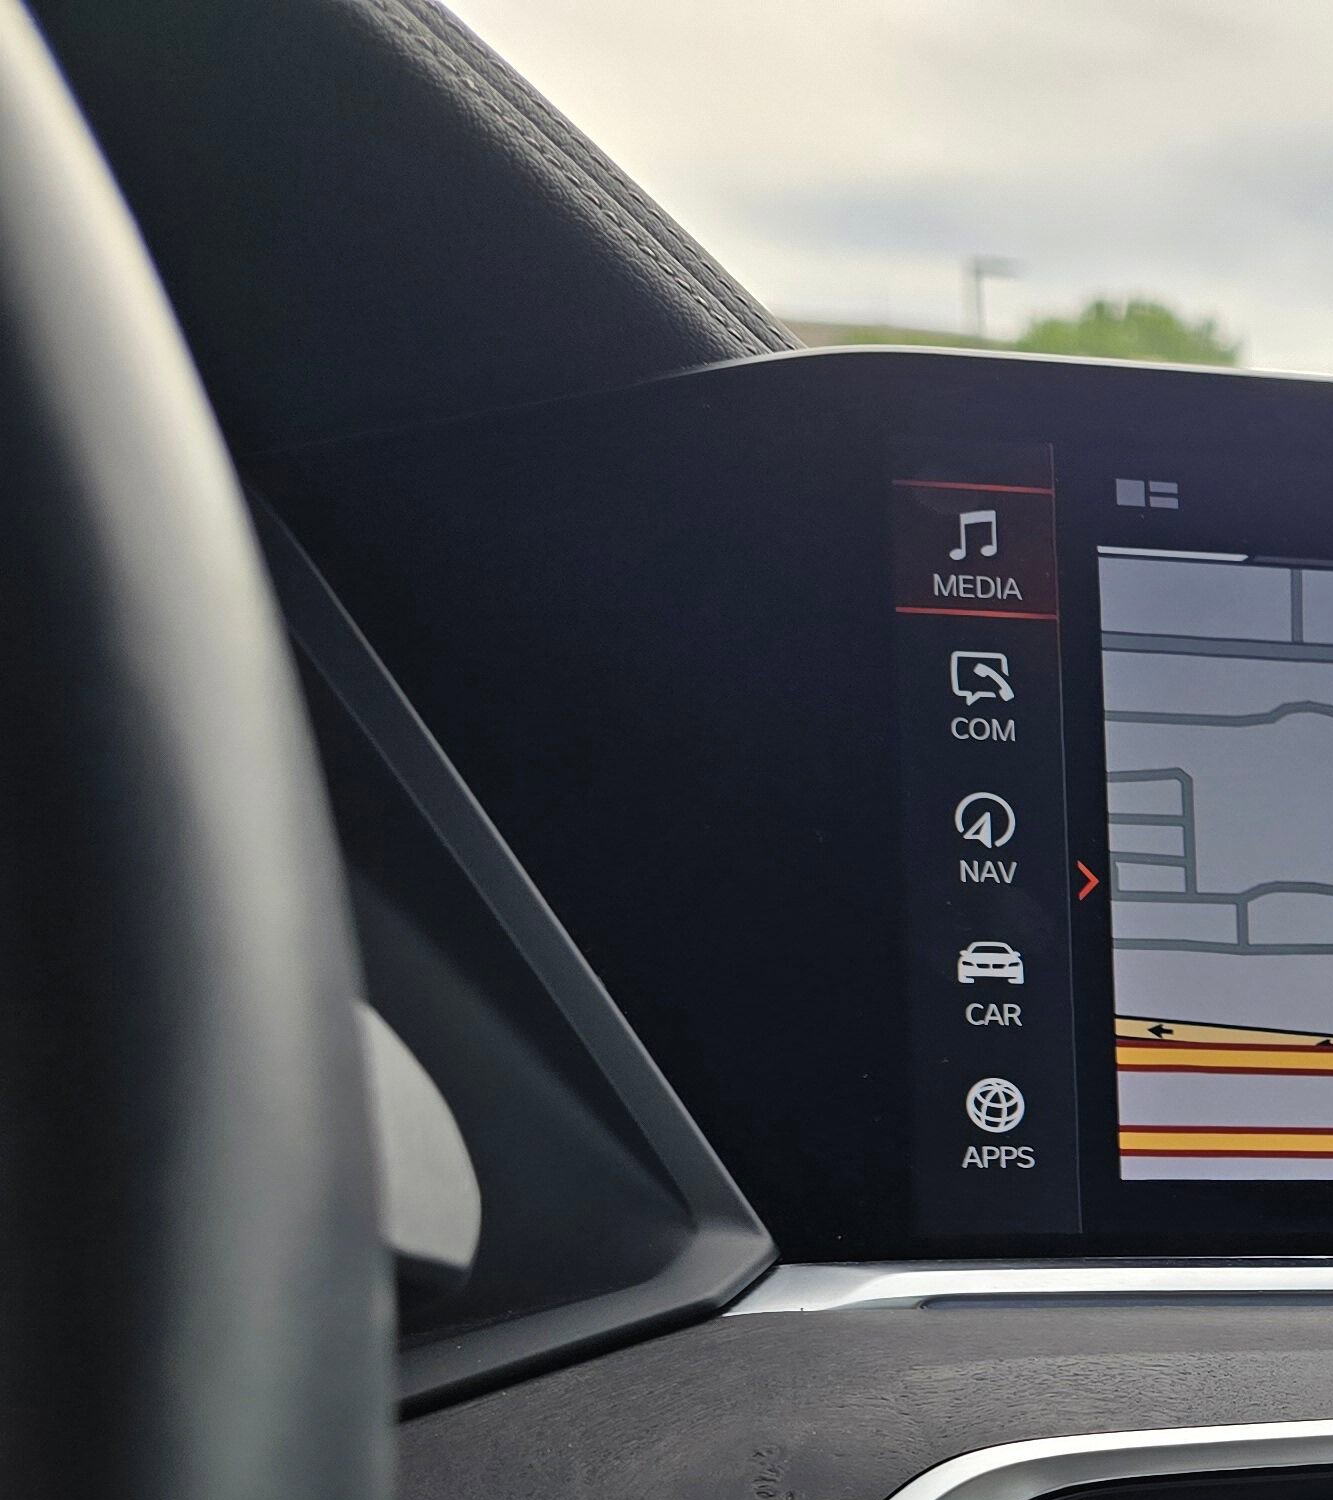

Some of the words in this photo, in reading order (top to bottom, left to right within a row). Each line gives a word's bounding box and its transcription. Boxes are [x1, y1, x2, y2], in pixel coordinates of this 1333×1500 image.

[933, 573, 1023, 601] MEDIA
[950, 716, 1017, 743] COM
[959, 858, 1018, 885] NAV
[964, 1002, 1023, 1028] CAR
[960, 1144, 1037, 1171] APPS
